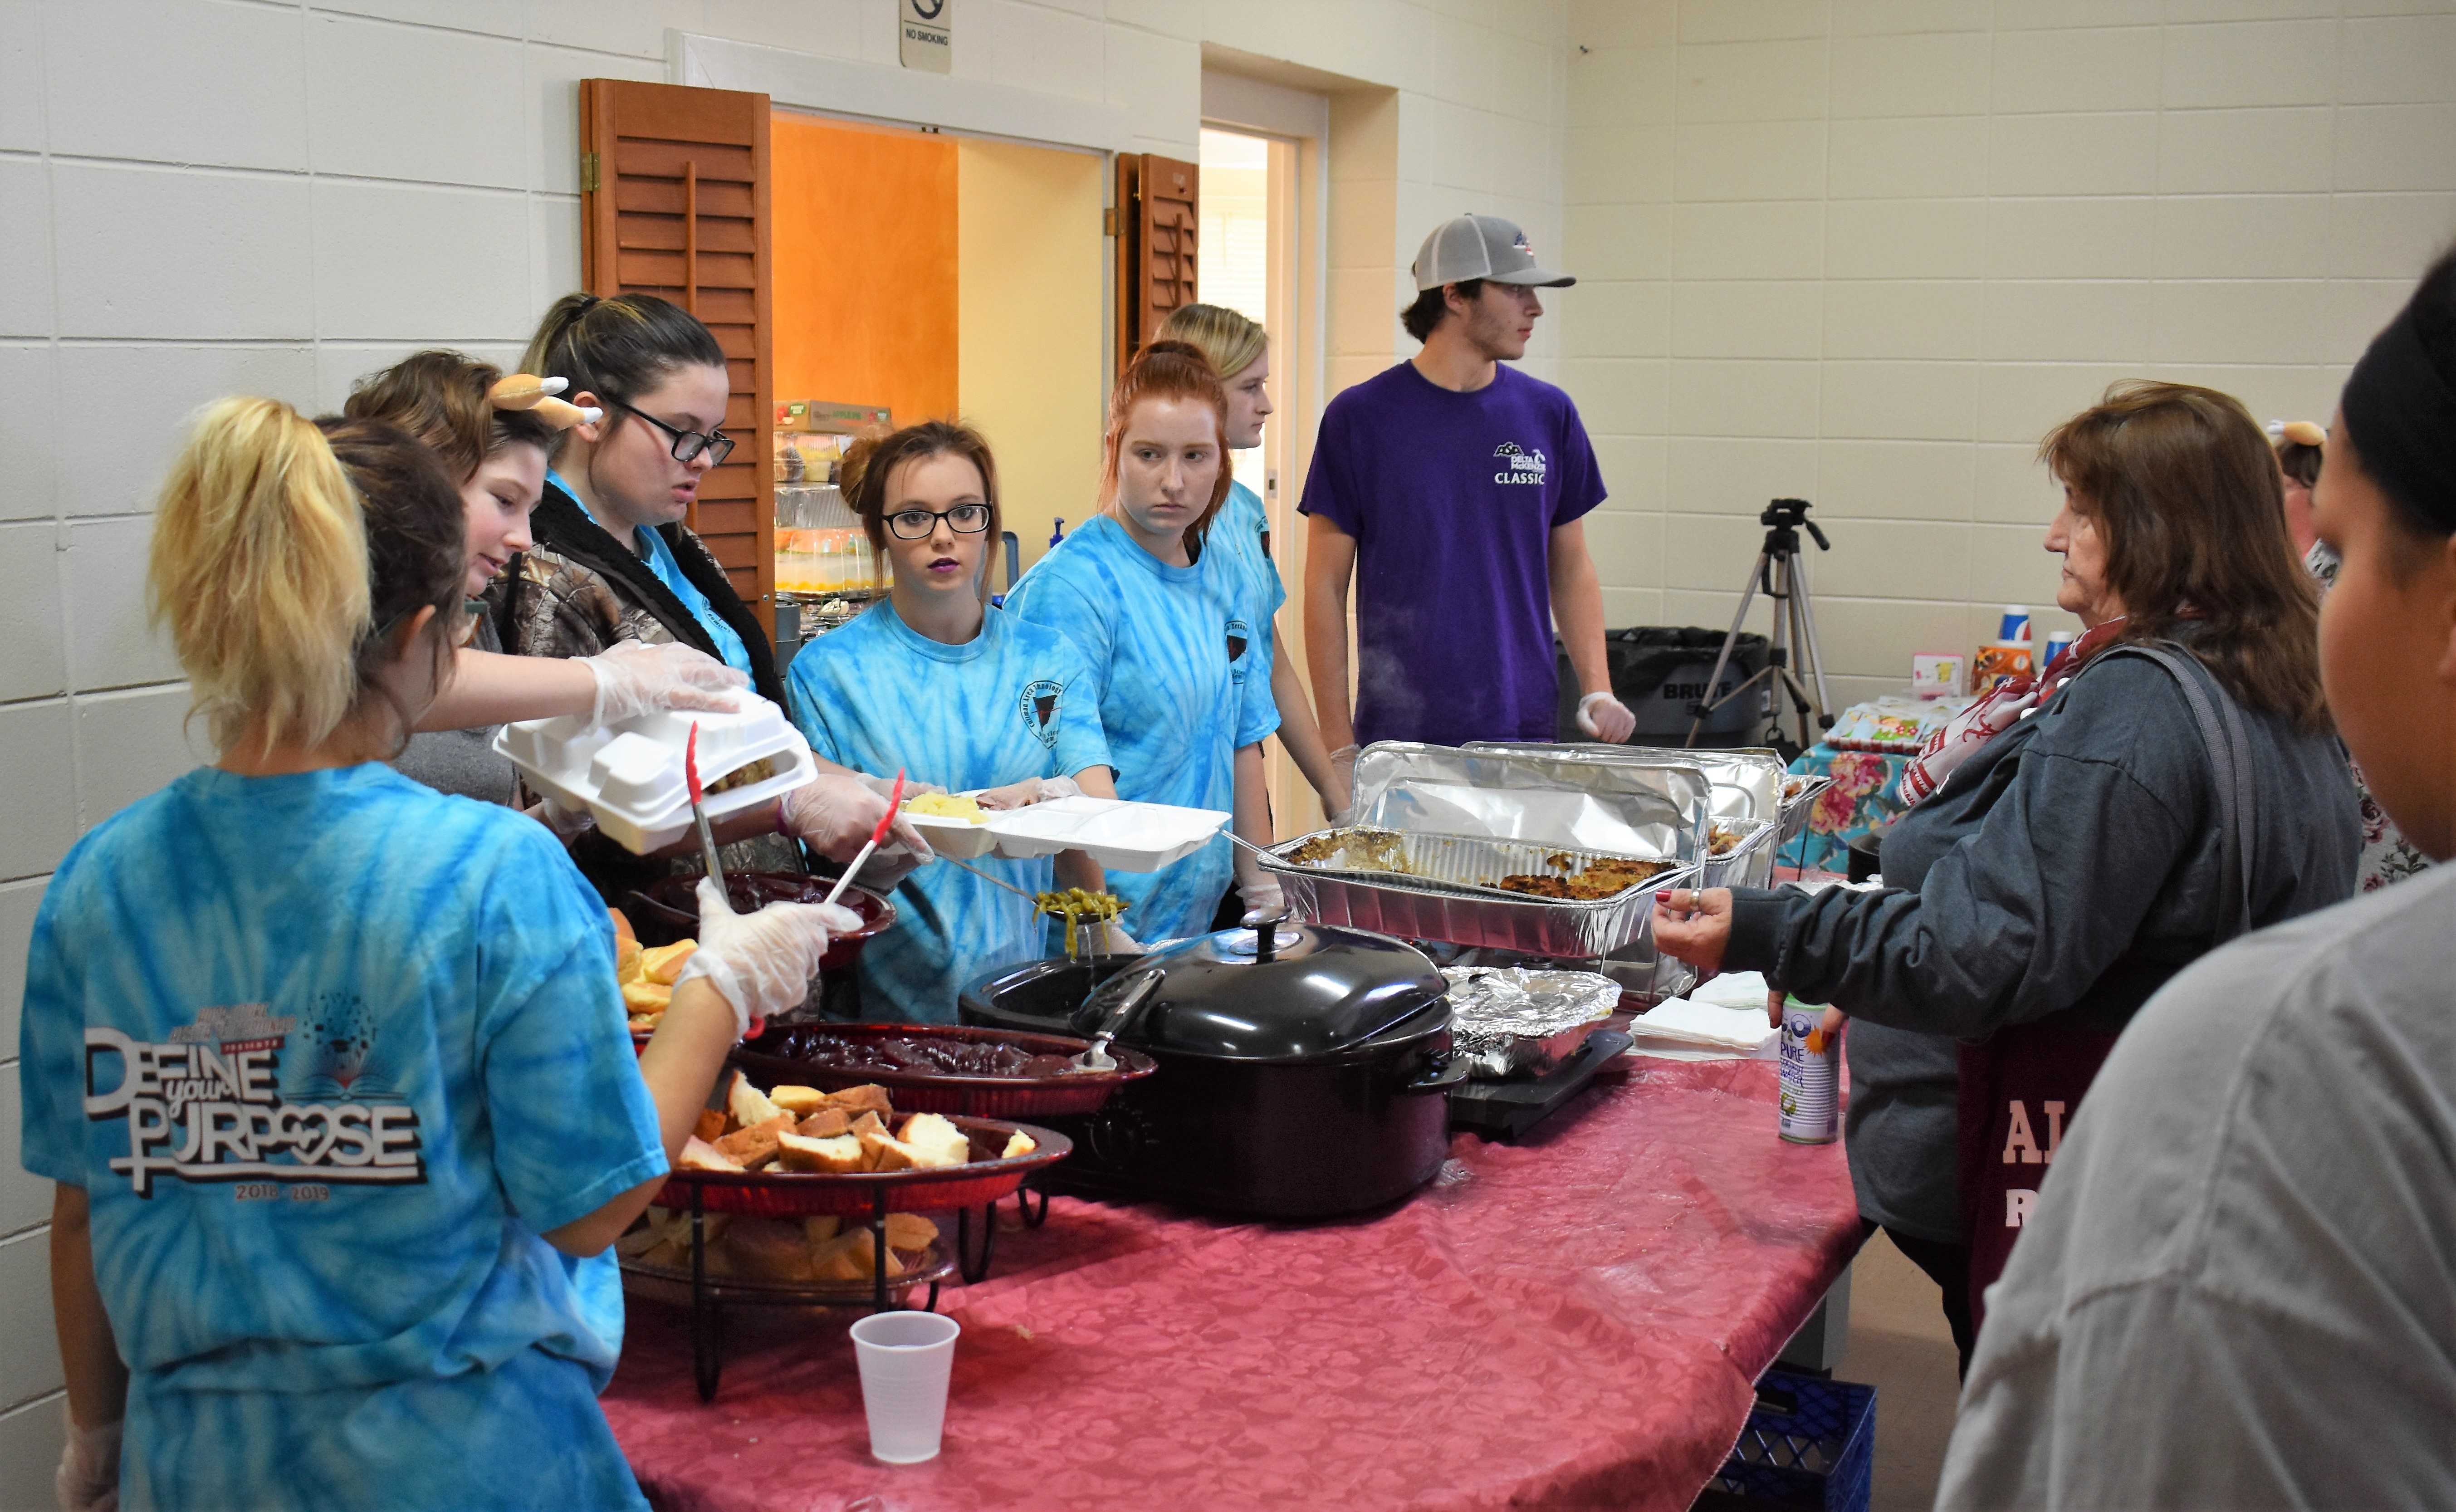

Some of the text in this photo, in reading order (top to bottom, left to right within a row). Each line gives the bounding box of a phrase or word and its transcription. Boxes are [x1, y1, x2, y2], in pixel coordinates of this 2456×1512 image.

[906, 29, 948, 45] NO SMOKING
[1495, 472, 1545, 484] CLASSIC
[1781, 1042, 1804, 1063] PURE
[84, 1026, 280, 1121] DEFINE
[1780, 1067, 1804, 1088] WATER
[166, 1077, 232, 1119] your
